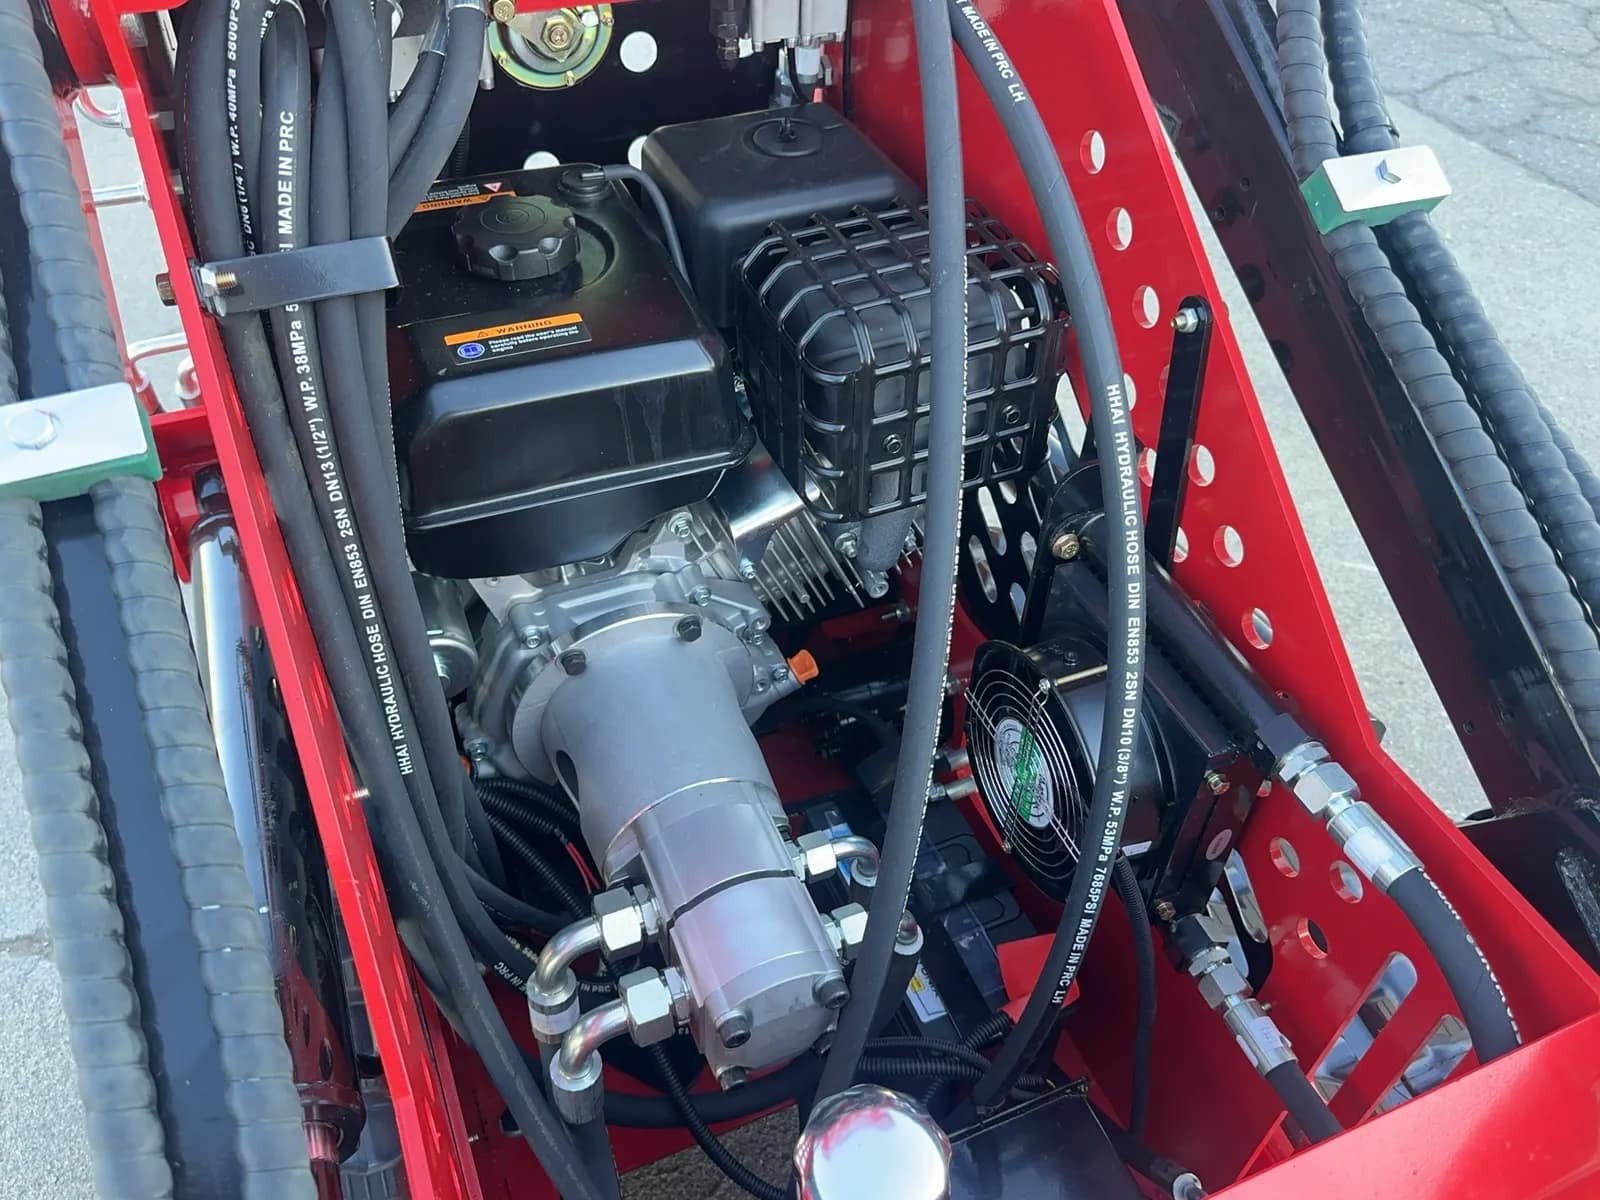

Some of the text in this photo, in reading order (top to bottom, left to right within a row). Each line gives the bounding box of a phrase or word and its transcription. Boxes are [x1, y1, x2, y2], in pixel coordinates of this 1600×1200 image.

[961, 6, 991, 39] MADE
[983, 38, 1000, 52] IN
[991, 52, 1014, 79] PRC
[227, 68, 238, 122] 40MPa
[1007, 83, 1026, 103] LH
[279, 111, 294, 152] PRC
[277, 156, 293, 176] IN
[277, 180, 293, 234] MADE
[496, 319, 552, 335] WARNING
[289, 320, 311, 374] 38MPa
[299, 376, 319, 412] W.P.
[307, 417, 333, 459] (1/2")
[320, 461, 344, 502] DN13
[333, 507, 354, 538] 2SN
[344, 543, 369, 589] EN853
[357, 593, 377, 621] DIN
[366, 623, 387, 664] HOSE
[375, 664, 405, 741] HYDRAULIC
[1051, 383, 1141, 1004] HHAI HYDRAULIC HOSE DIN EN853 2SN DN10 (3/8") W.P. 53MPa 7685PSI MADE IN PRC LH
[395, 743, 414, 776] HHAI
[493, 961, 523, 989] IN PRC
[580, 982, 591, 992] IN
[591, 984, 611, 993] PRC
